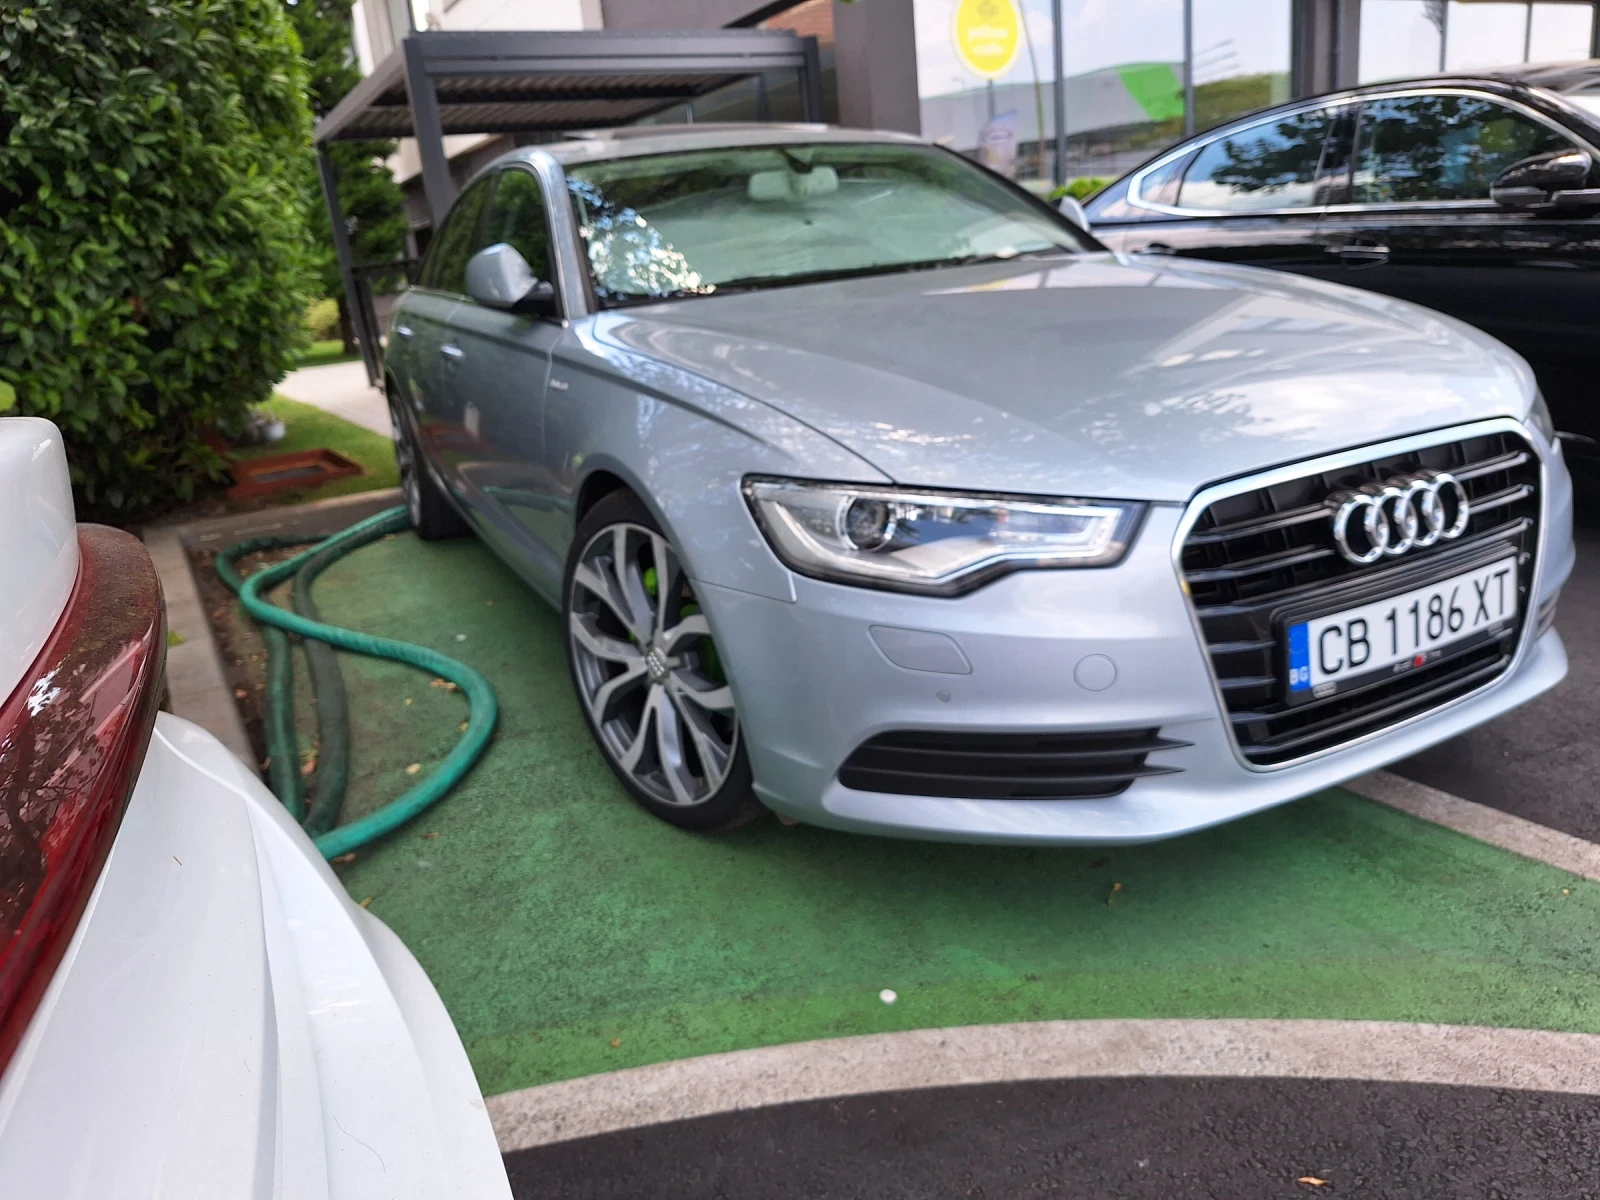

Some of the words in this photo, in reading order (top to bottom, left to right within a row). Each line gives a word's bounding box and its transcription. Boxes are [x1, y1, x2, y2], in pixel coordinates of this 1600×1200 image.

[1318, 618, 1370, 675] CB
[1385, 586, 1464, 655] 1186
[1473, 569, 1510, 626] XT
[1289, 665, 1309, 686] BG
